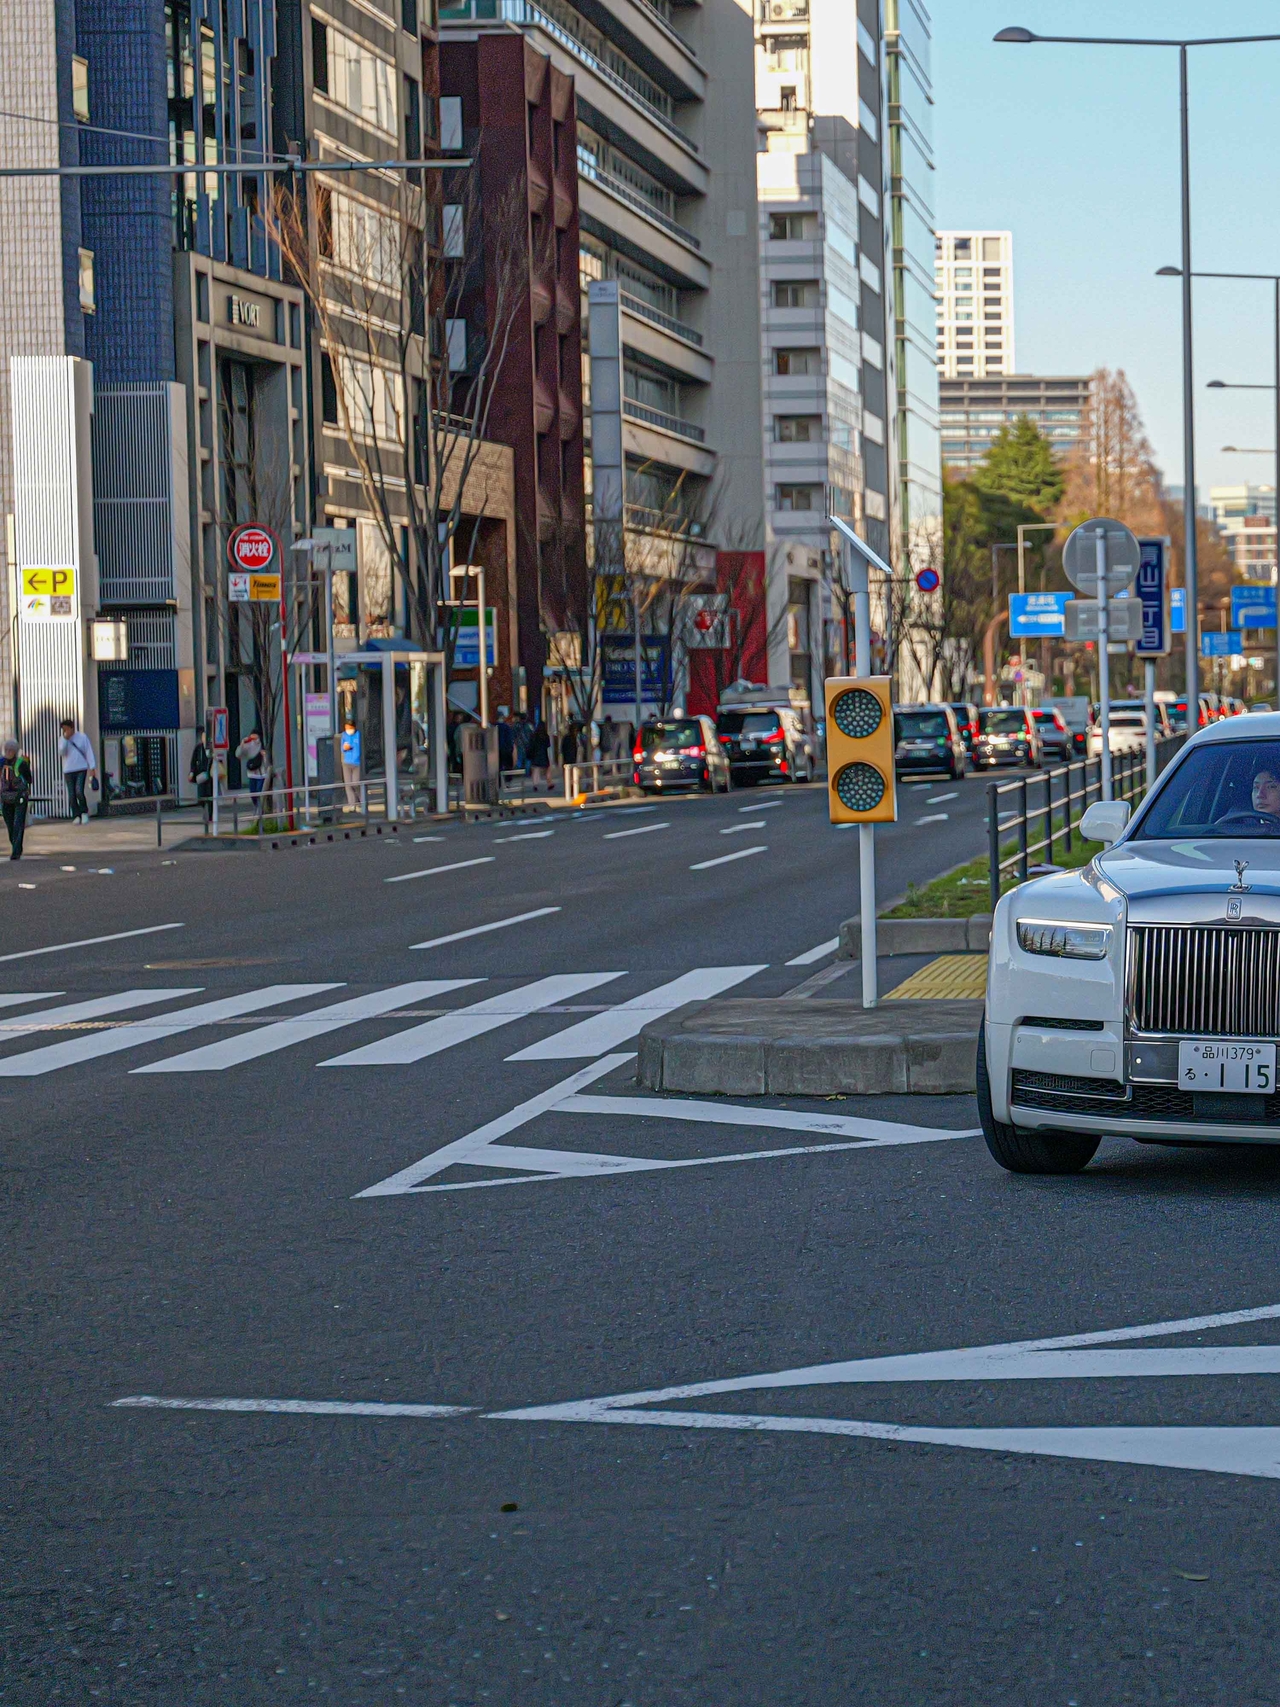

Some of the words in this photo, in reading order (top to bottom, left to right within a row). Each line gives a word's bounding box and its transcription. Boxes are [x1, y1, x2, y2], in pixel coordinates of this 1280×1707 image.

[240, 300, 260, 327] VORT
[239, 542, 269, 557] 消火栓
[52, 571, 68, 593] P
[1202, 1046, 1254, 1060] 品川379
[1184, 1068, 1196, 1081] る
